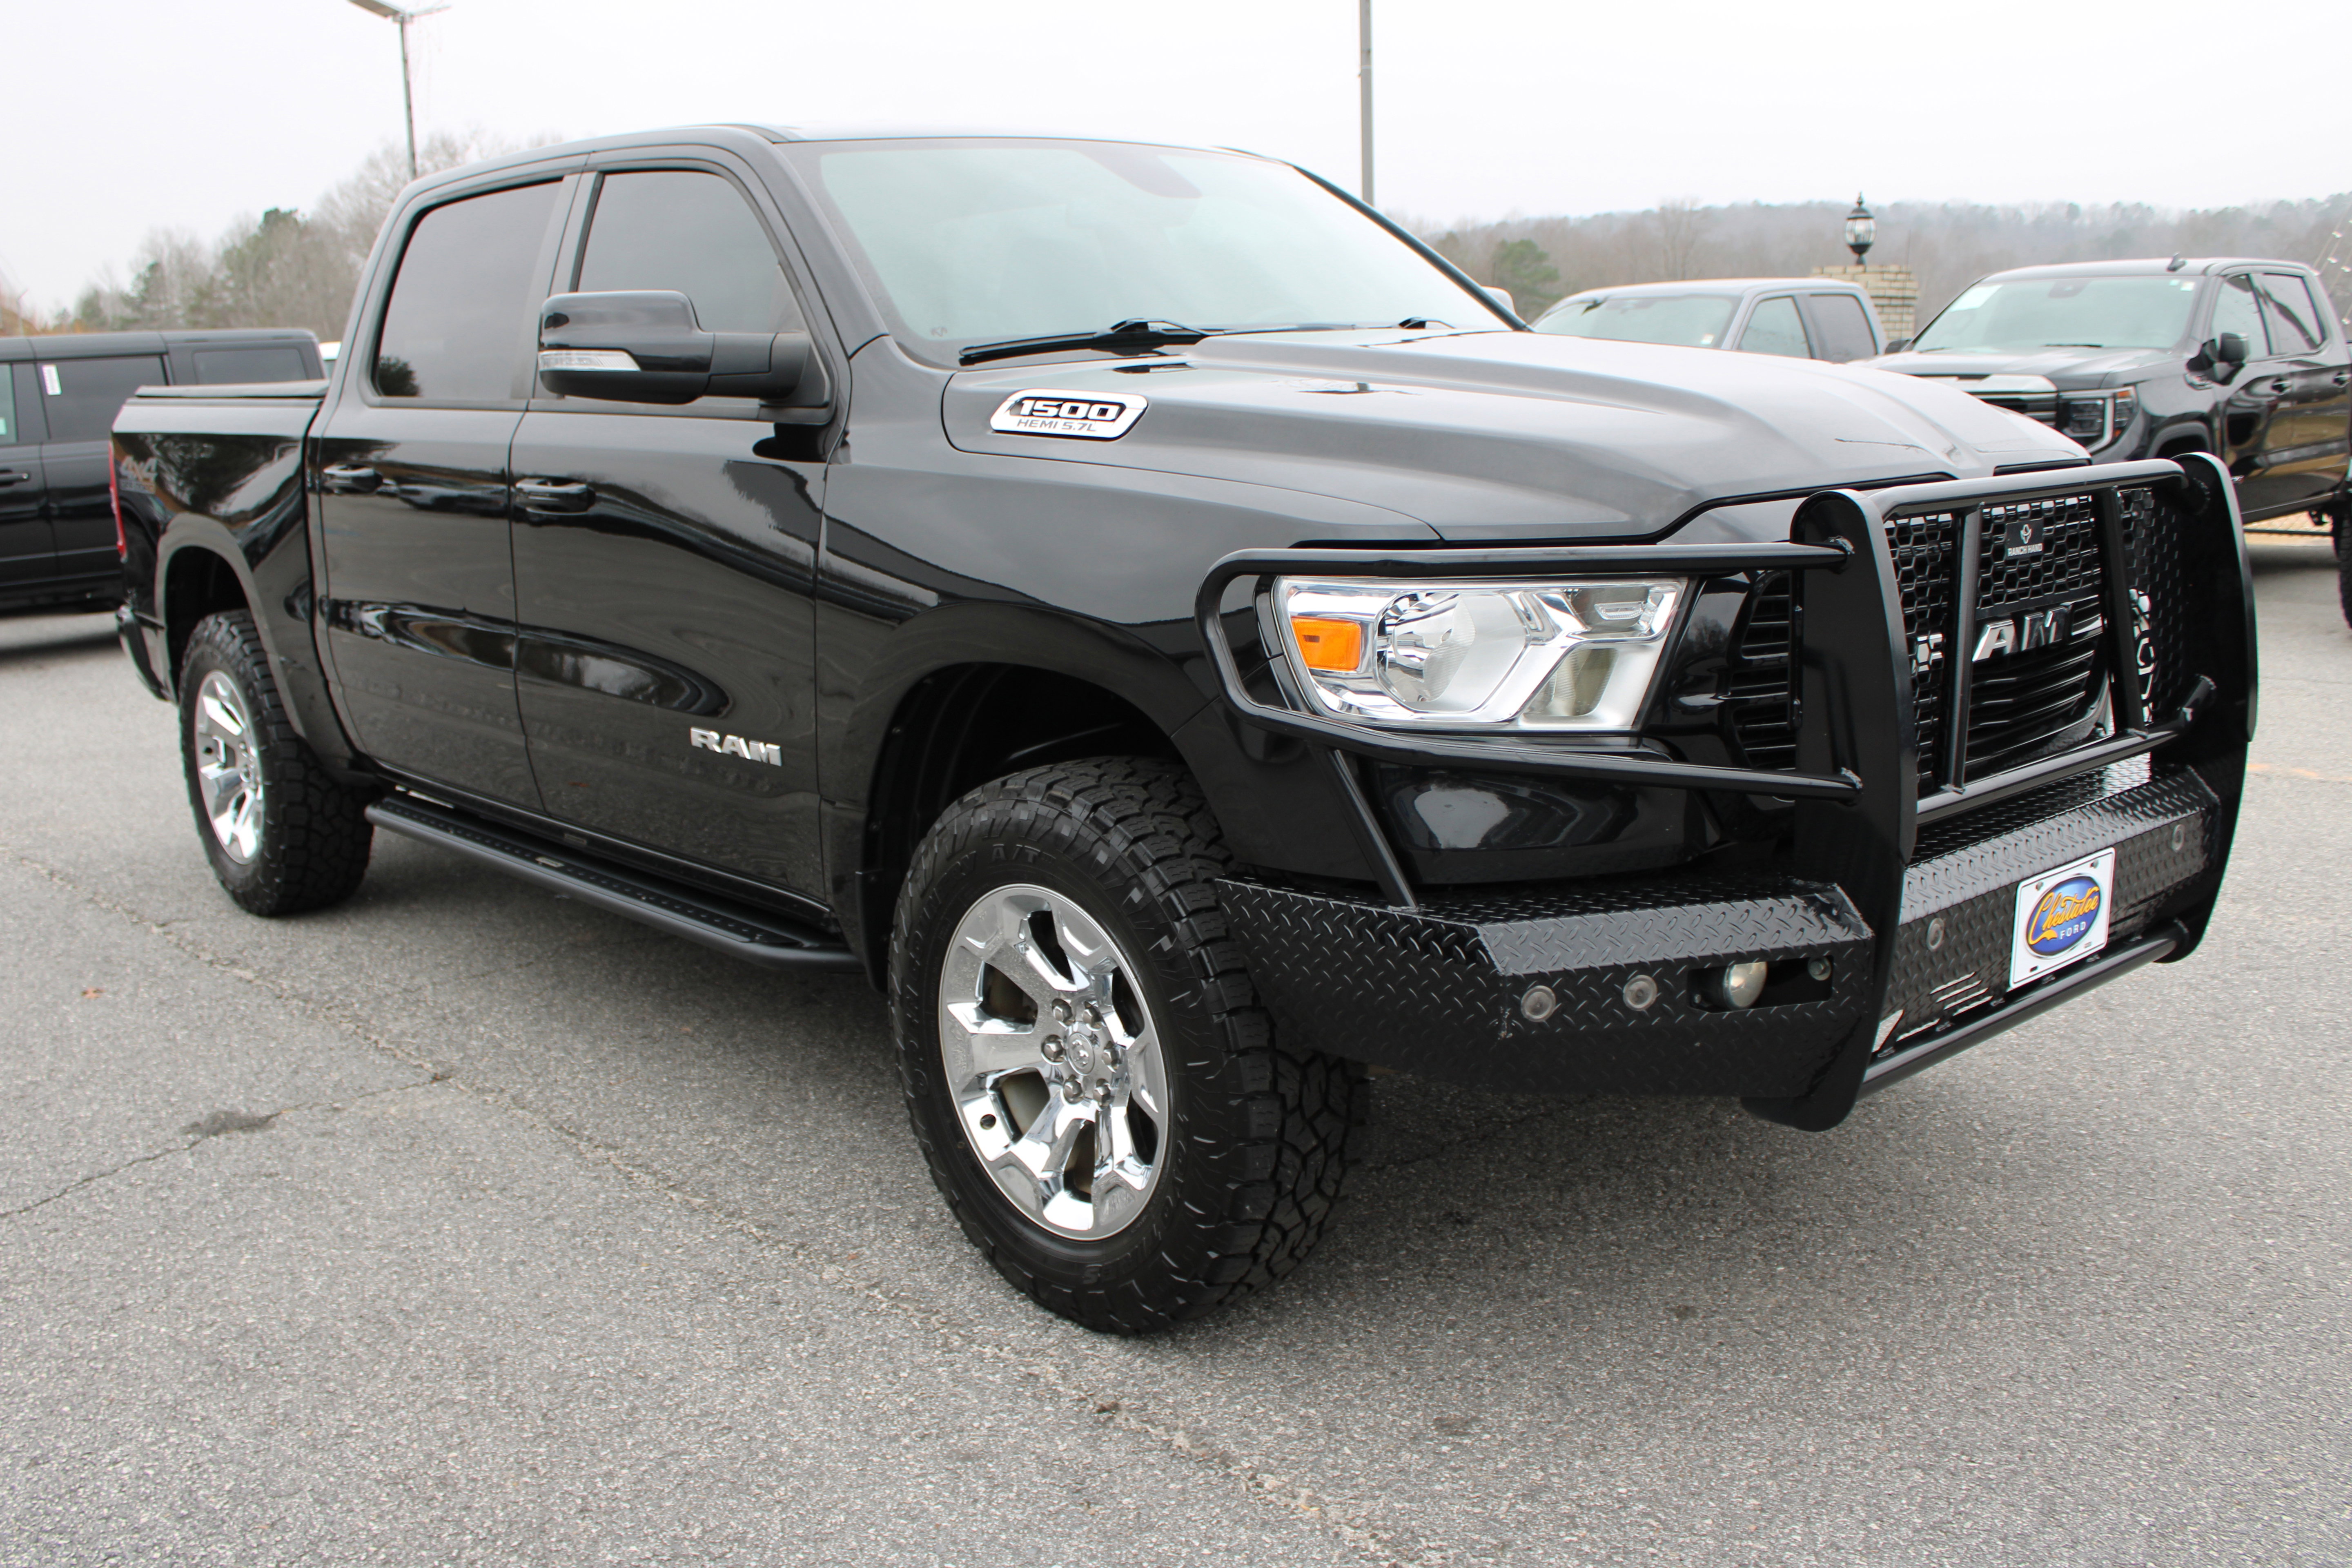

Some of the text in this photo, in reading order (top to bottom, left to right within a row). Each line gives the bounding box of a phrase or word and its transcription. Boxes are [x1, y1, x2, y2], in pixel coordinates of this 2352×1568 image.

[1020, 399, 1119, 421] 1500
[1016, 419, 1097, 432] HEMI 5.7L
[2007, 543, 2043, 557] RANCH HAND
[690, 726, 782, 766] RAM
[992, 844, 1041, 864] A/T
[2059, 921, 2086, 940] FORD
